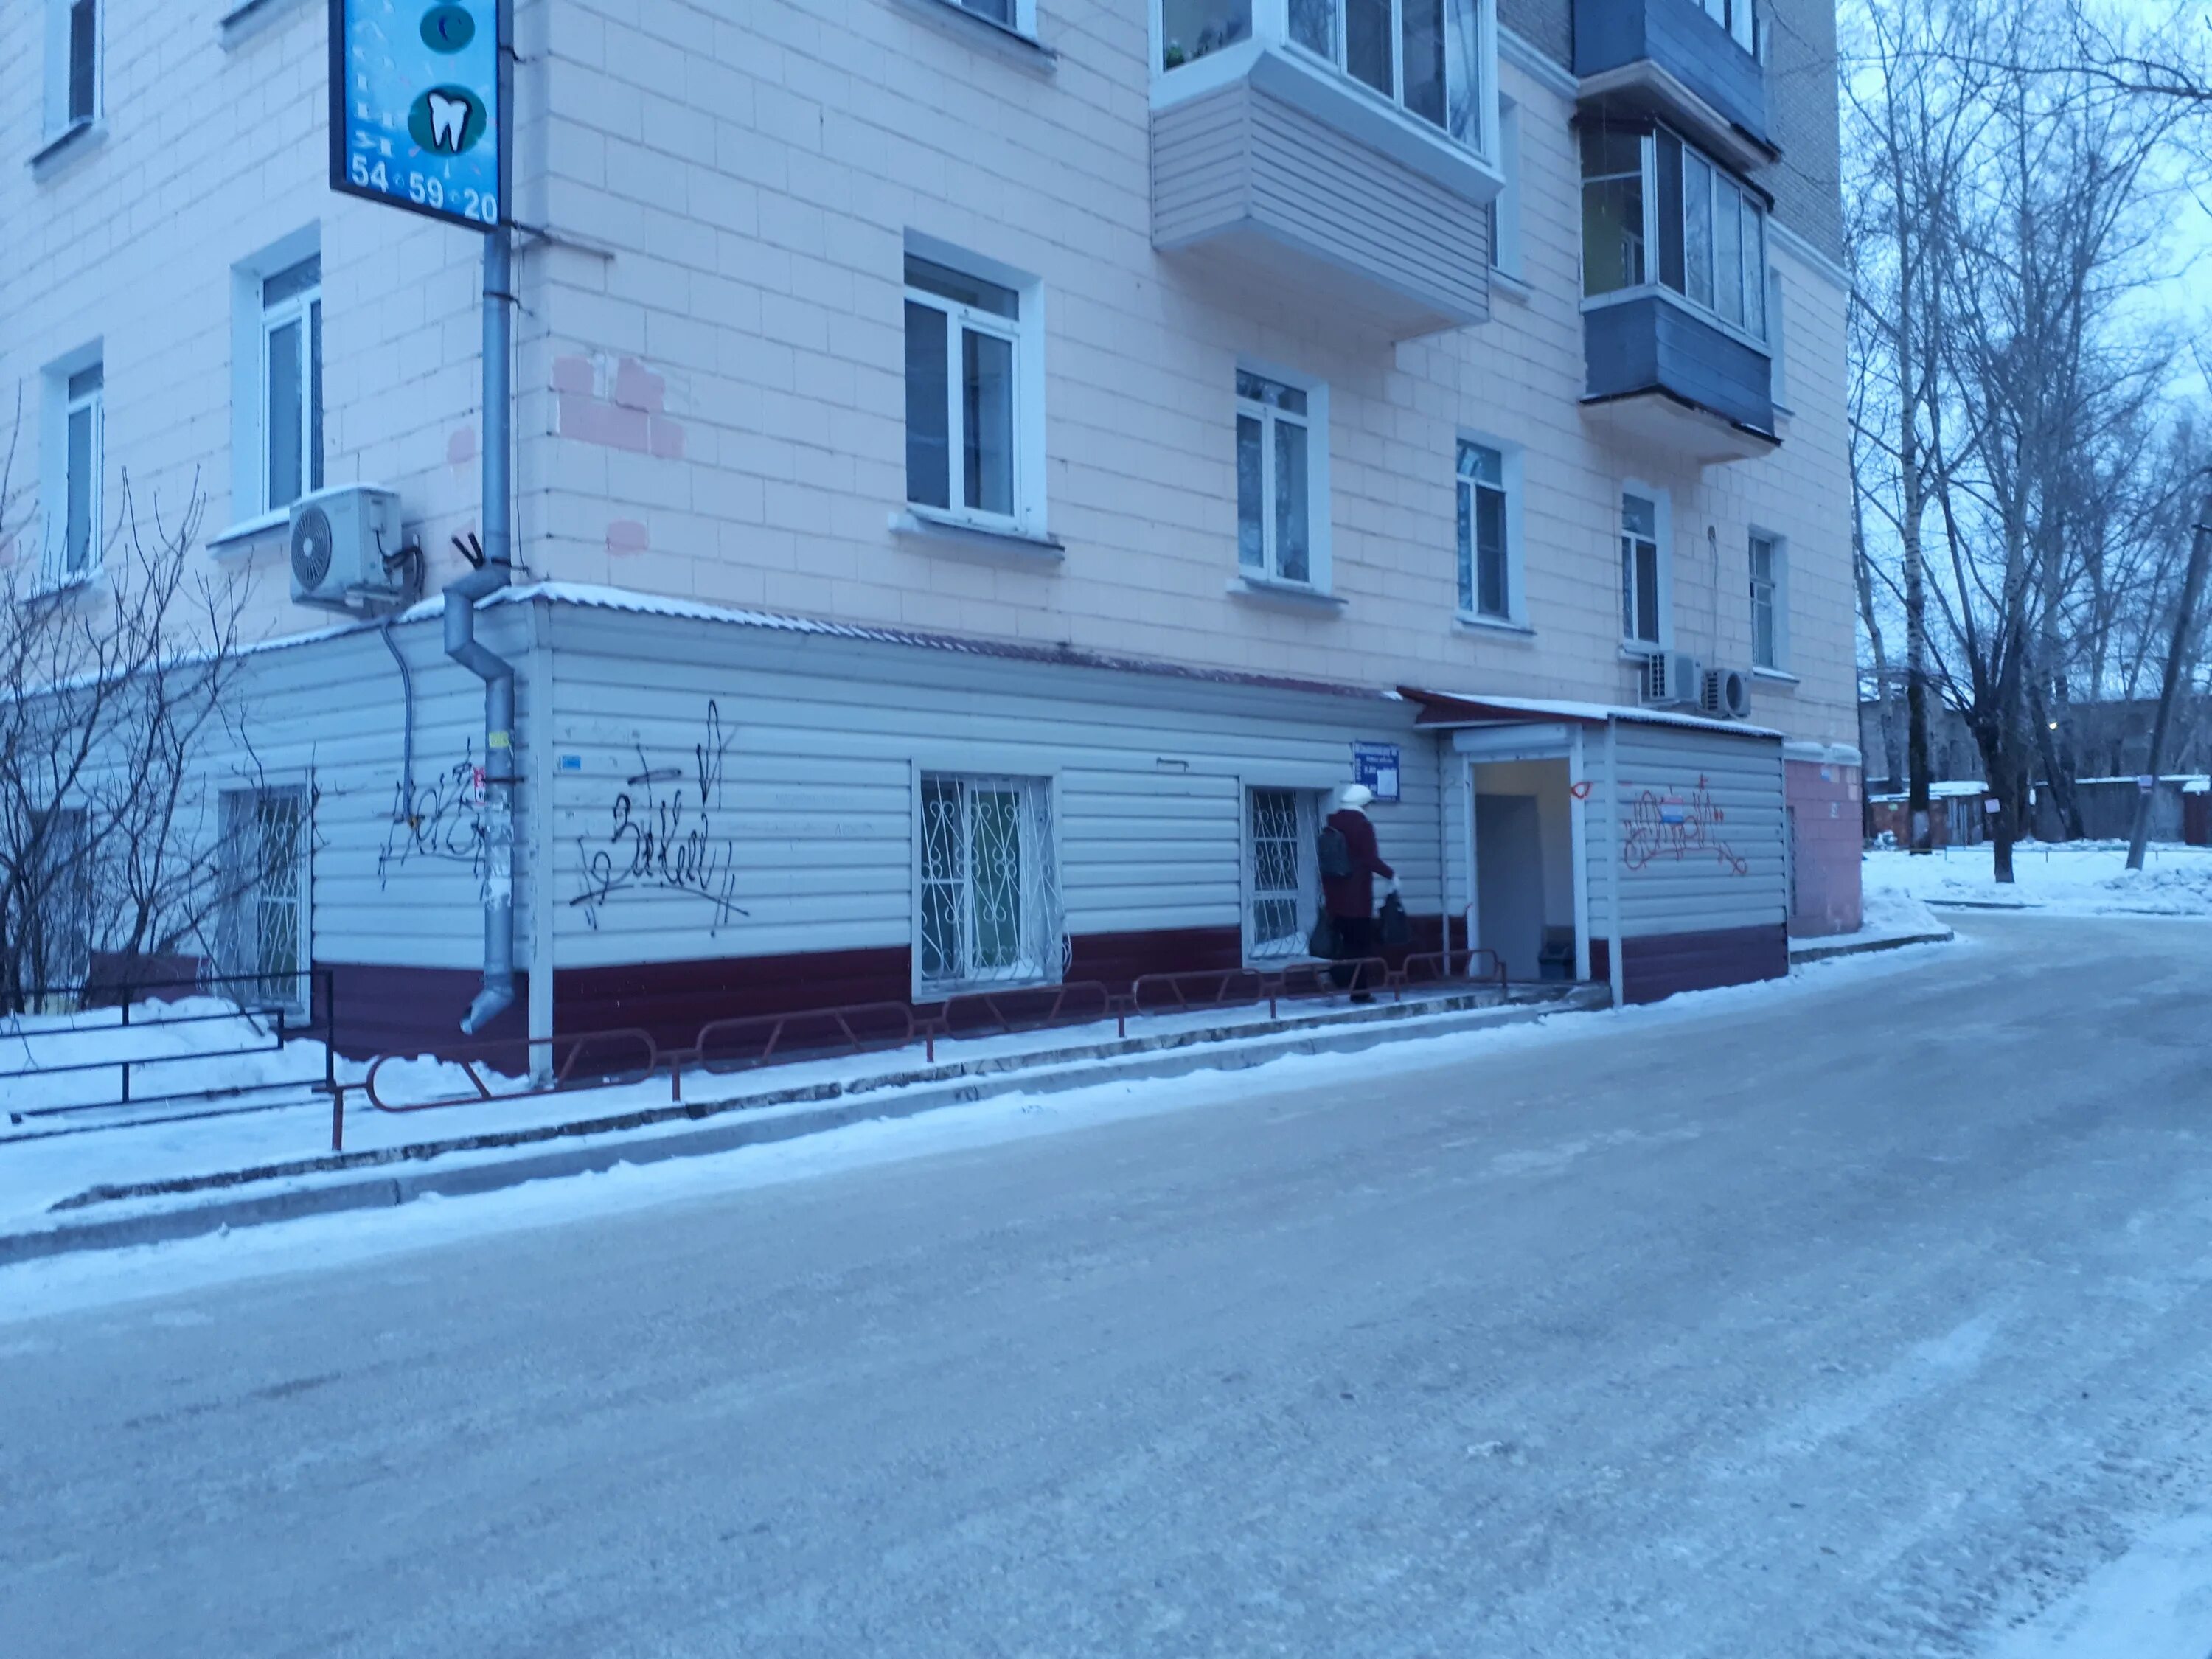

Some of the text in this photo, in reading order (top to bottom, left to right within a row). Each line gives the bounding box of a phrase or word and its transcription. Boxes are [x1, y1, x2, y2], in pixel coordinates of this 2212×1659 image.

[352, 153, 498, 225] 54 59 20
